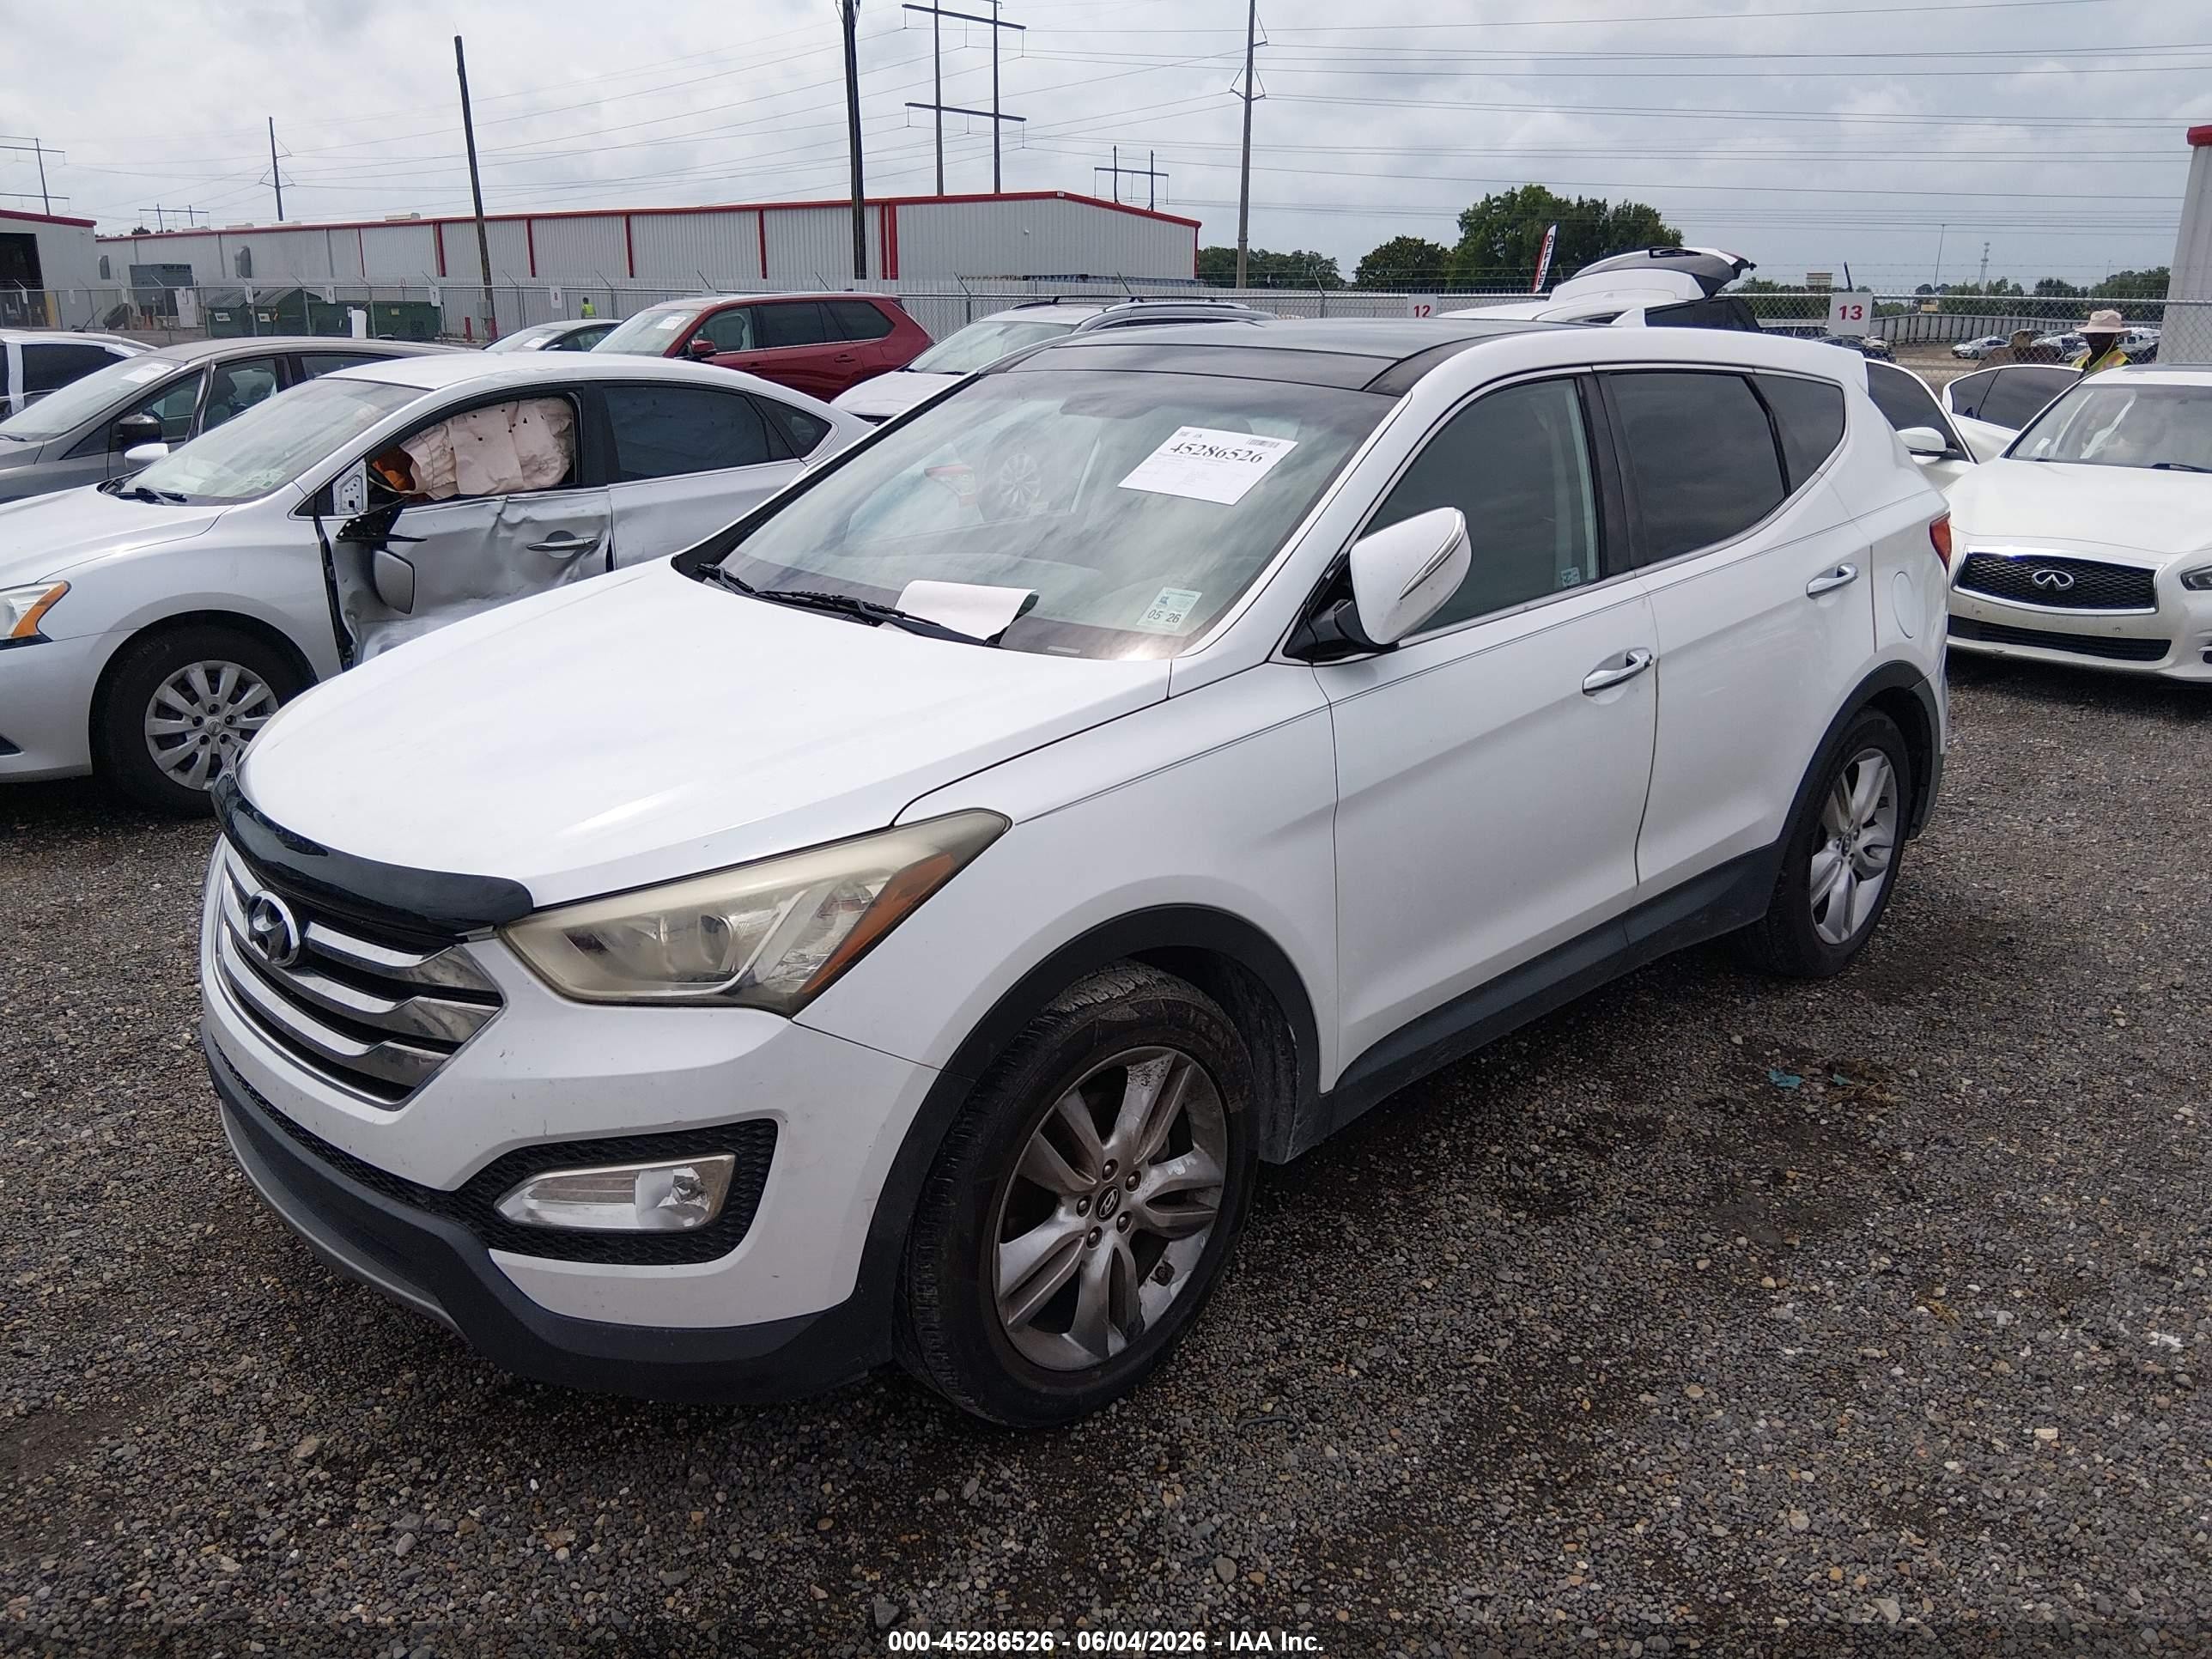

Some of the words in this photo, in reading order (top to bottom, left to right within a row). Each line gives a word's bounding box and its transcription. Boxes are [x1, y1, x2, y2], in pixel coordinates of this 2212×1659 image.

[1538, 234, 1553, 286] OFFICE
[1413, 305, 1431, 318] 12
[1839, 305, 1863, 320] 13
[1170, 441, 1267, 464] 45286526
[1147, 609, 1164, 620] 05
[1166, 612, 1182, 623] 26
